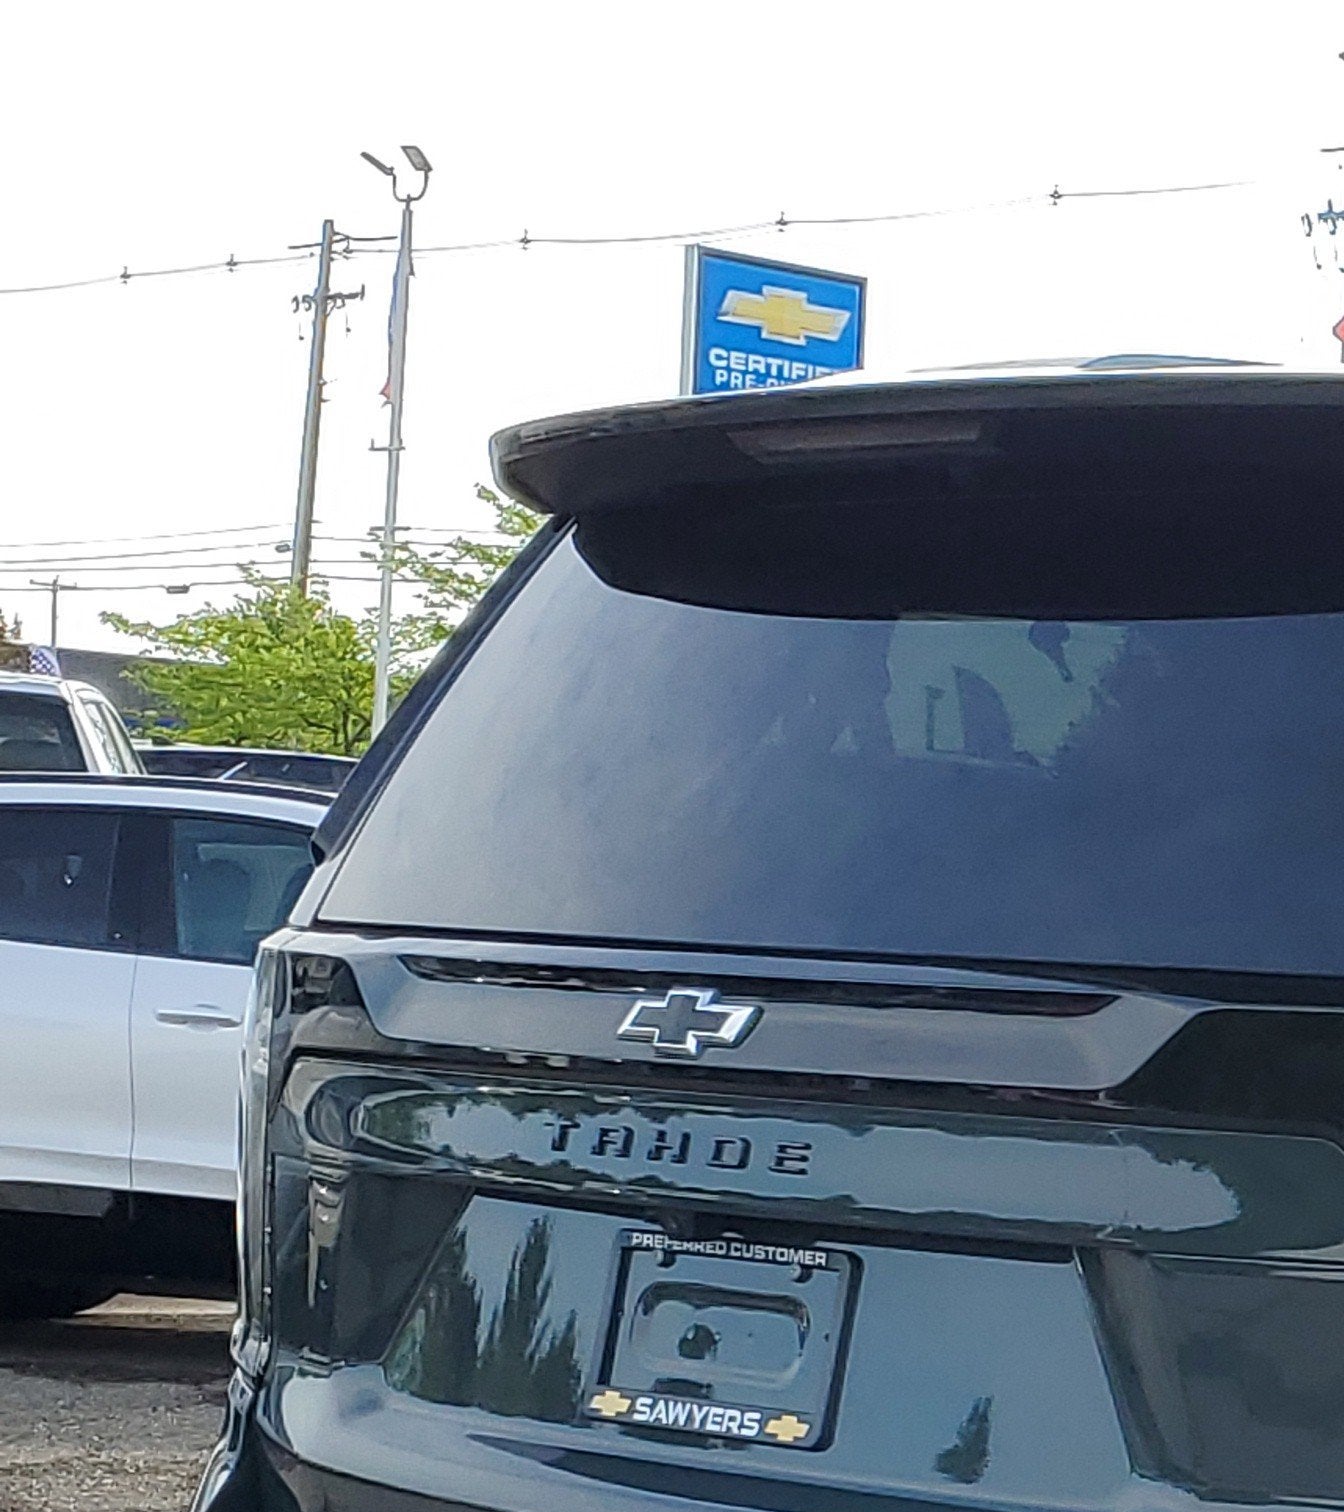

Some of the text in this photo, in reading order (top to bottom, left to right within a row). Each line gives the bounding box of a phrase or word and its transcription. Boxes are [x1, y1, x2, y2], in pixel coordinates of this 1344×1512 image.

[544, 1119, 813, 1176] TAHOE
[728, 1242, 828, 1267] CUSTOMER
[632, 1396, 762, 1438] SAWYERS
